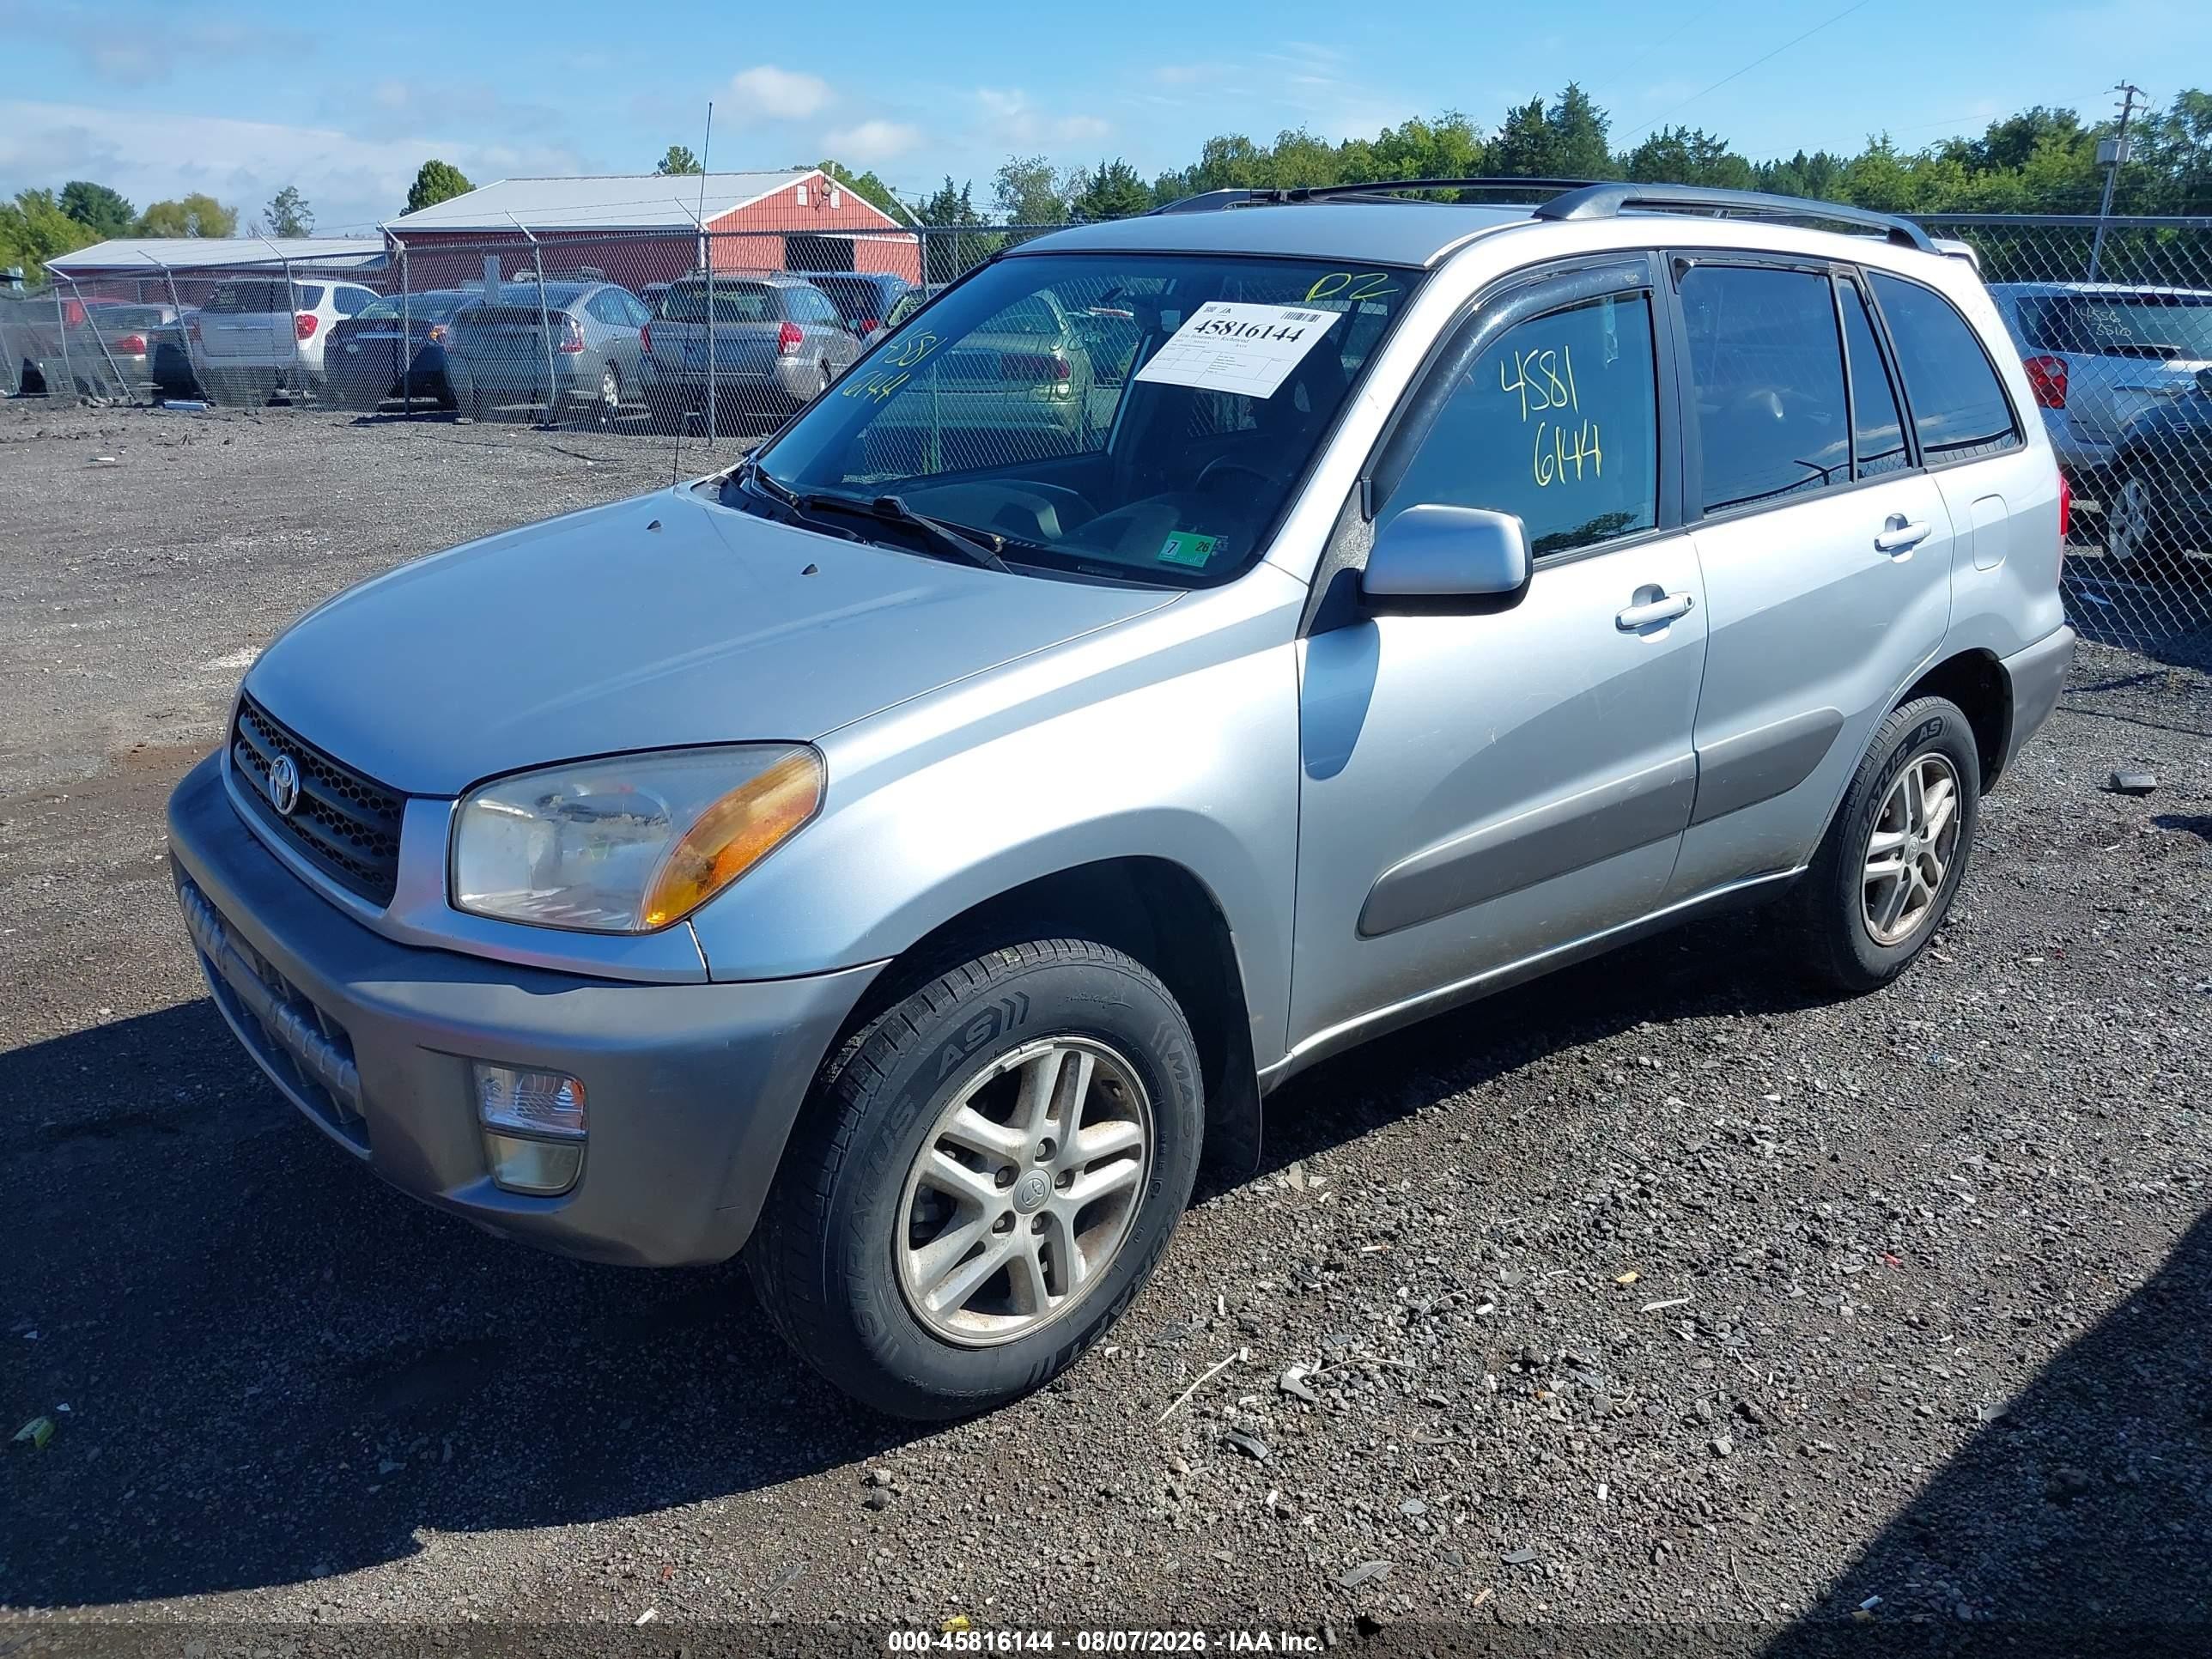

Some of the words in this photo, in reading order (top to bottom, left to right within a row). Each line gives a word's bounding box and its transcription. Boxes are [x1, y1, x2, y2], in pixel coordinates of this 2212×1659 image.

[1194, 319, 1306, 343] 45816144
[842, 371, 910, 404] 6144
[1501, 345, 1578, 422] 4581
[1534, 419, 1601, 486] 6144
[1165, 541, 1180, 555] 7
[1195, 541, 1212, 554] 26
[1917, 720, 1942, 744] AS
[846, 1092, 916, 1336] STRATUS
[935, 1013, 994, 1082] AS
[1058, 1049, 1196, 1371] MASTCRAFT
